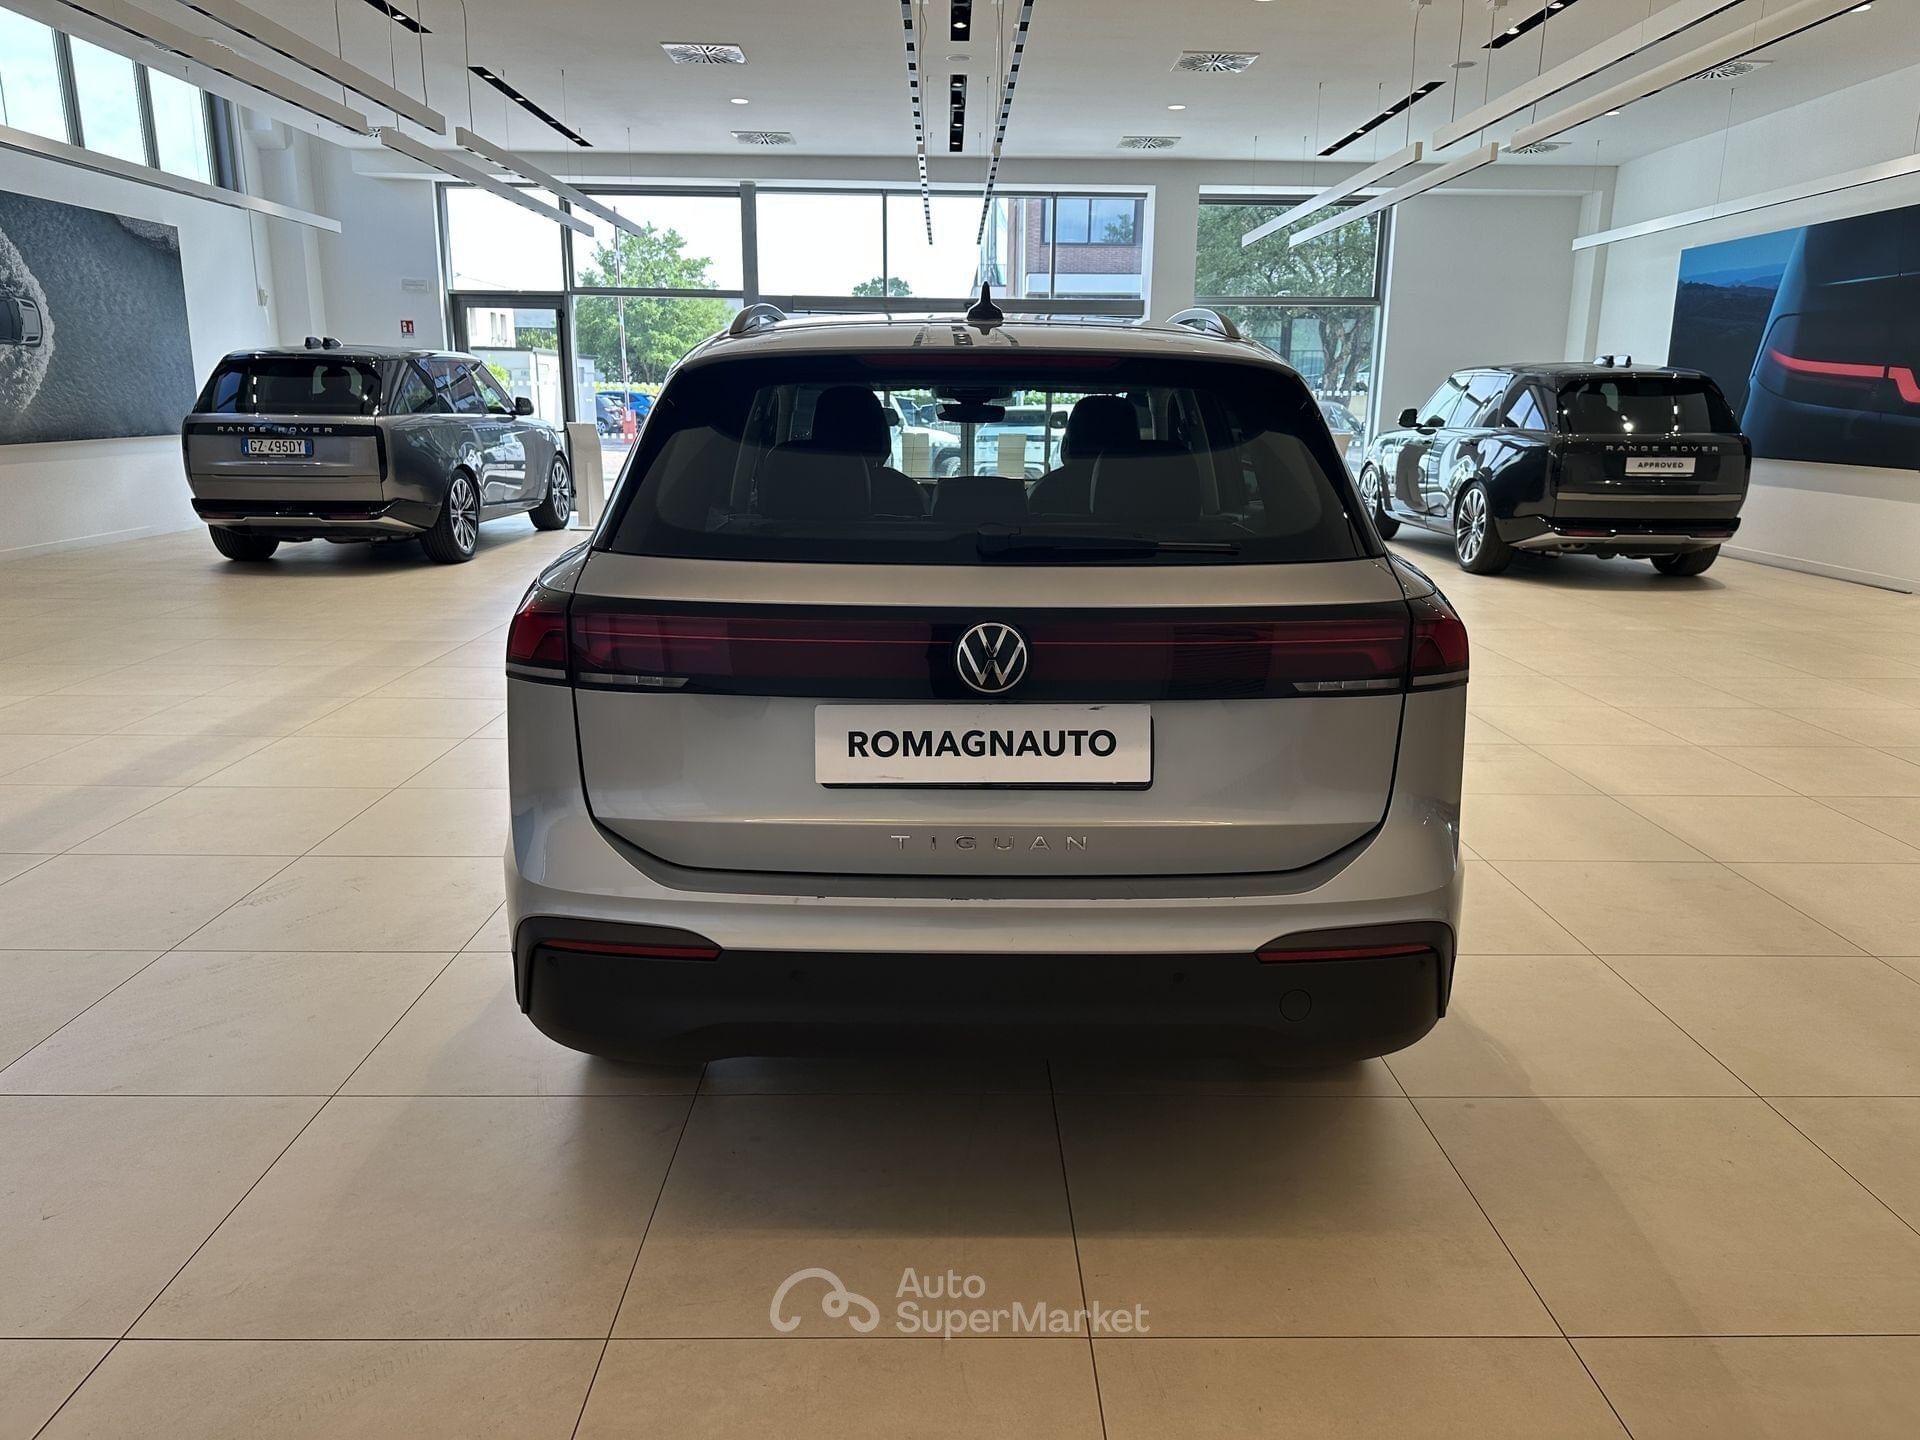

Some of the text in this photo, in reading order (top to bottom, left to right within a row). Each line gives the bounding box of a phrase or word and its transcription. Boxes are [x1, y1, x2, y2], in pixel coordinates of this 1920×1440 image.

[250, 440, 265, 453] GZ
[267, 440, 303, 453] 495DY
[1637, 461, 1684, 469] APPROVED
[847, 729, 1118, 758] ROMAGNAUTO
[890, 835, 1089, 851] TIGUAN
